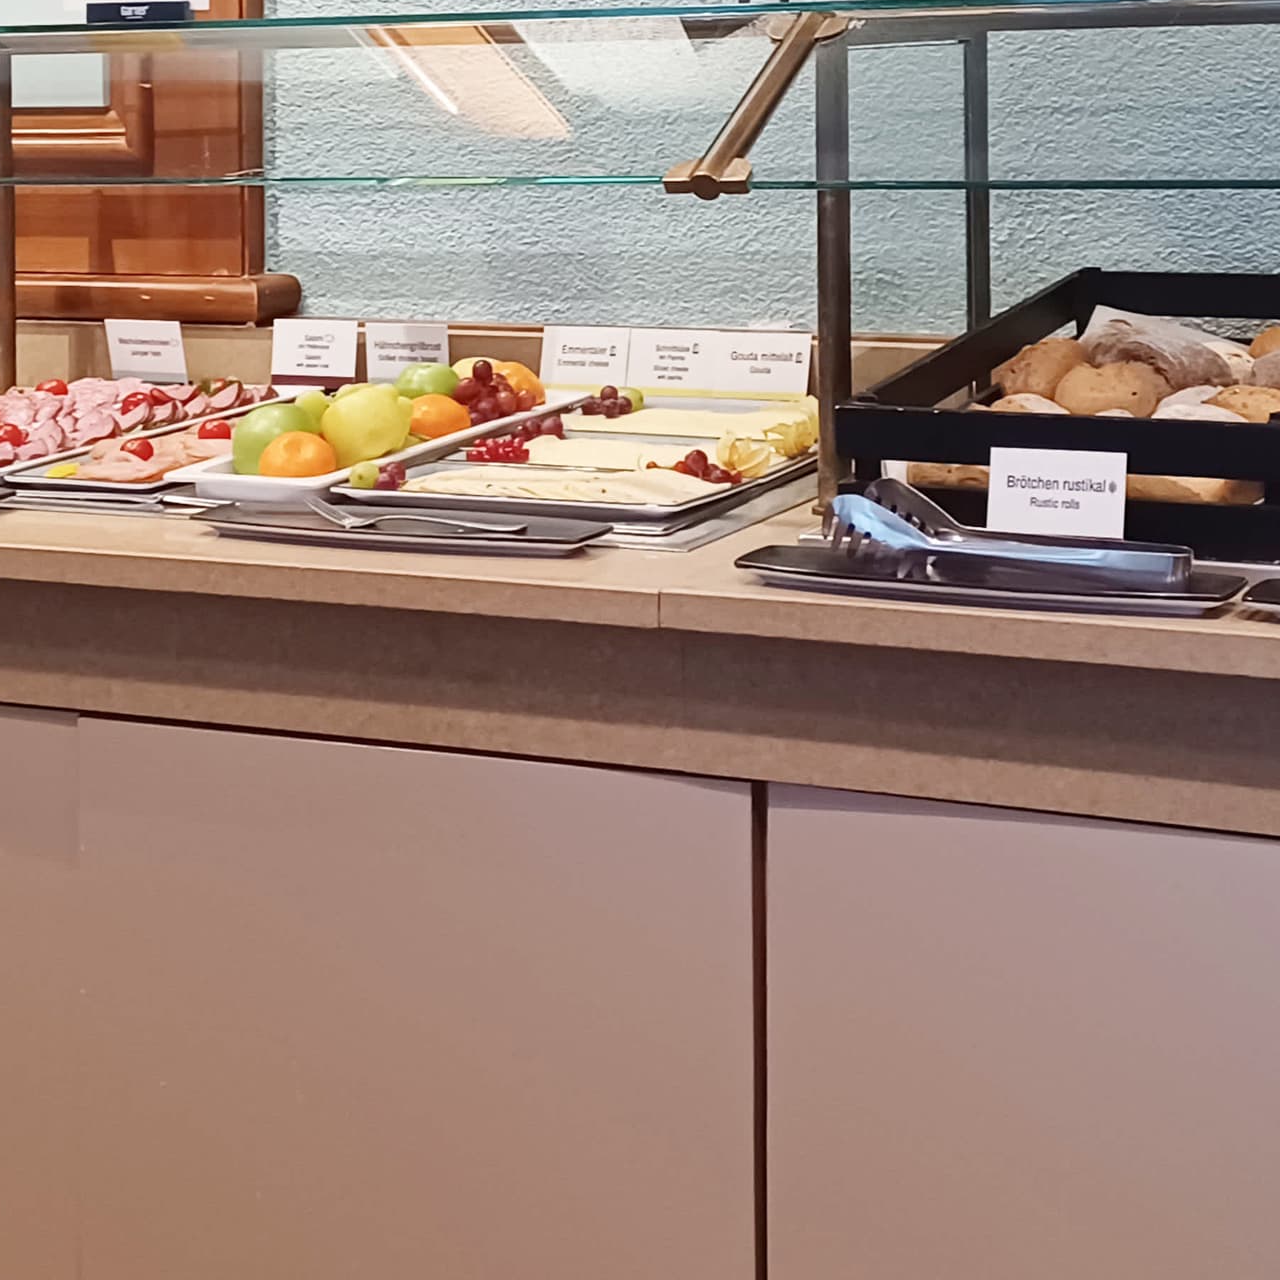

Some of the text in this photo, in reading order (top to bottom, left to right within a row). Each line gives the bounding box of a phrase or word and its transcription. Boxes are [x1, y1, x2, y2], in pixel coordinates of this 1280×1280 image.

[1006, 474, 1107, 493] Brötchen rustikal
[1029, 496, 1081, 510] Rustic rolls
